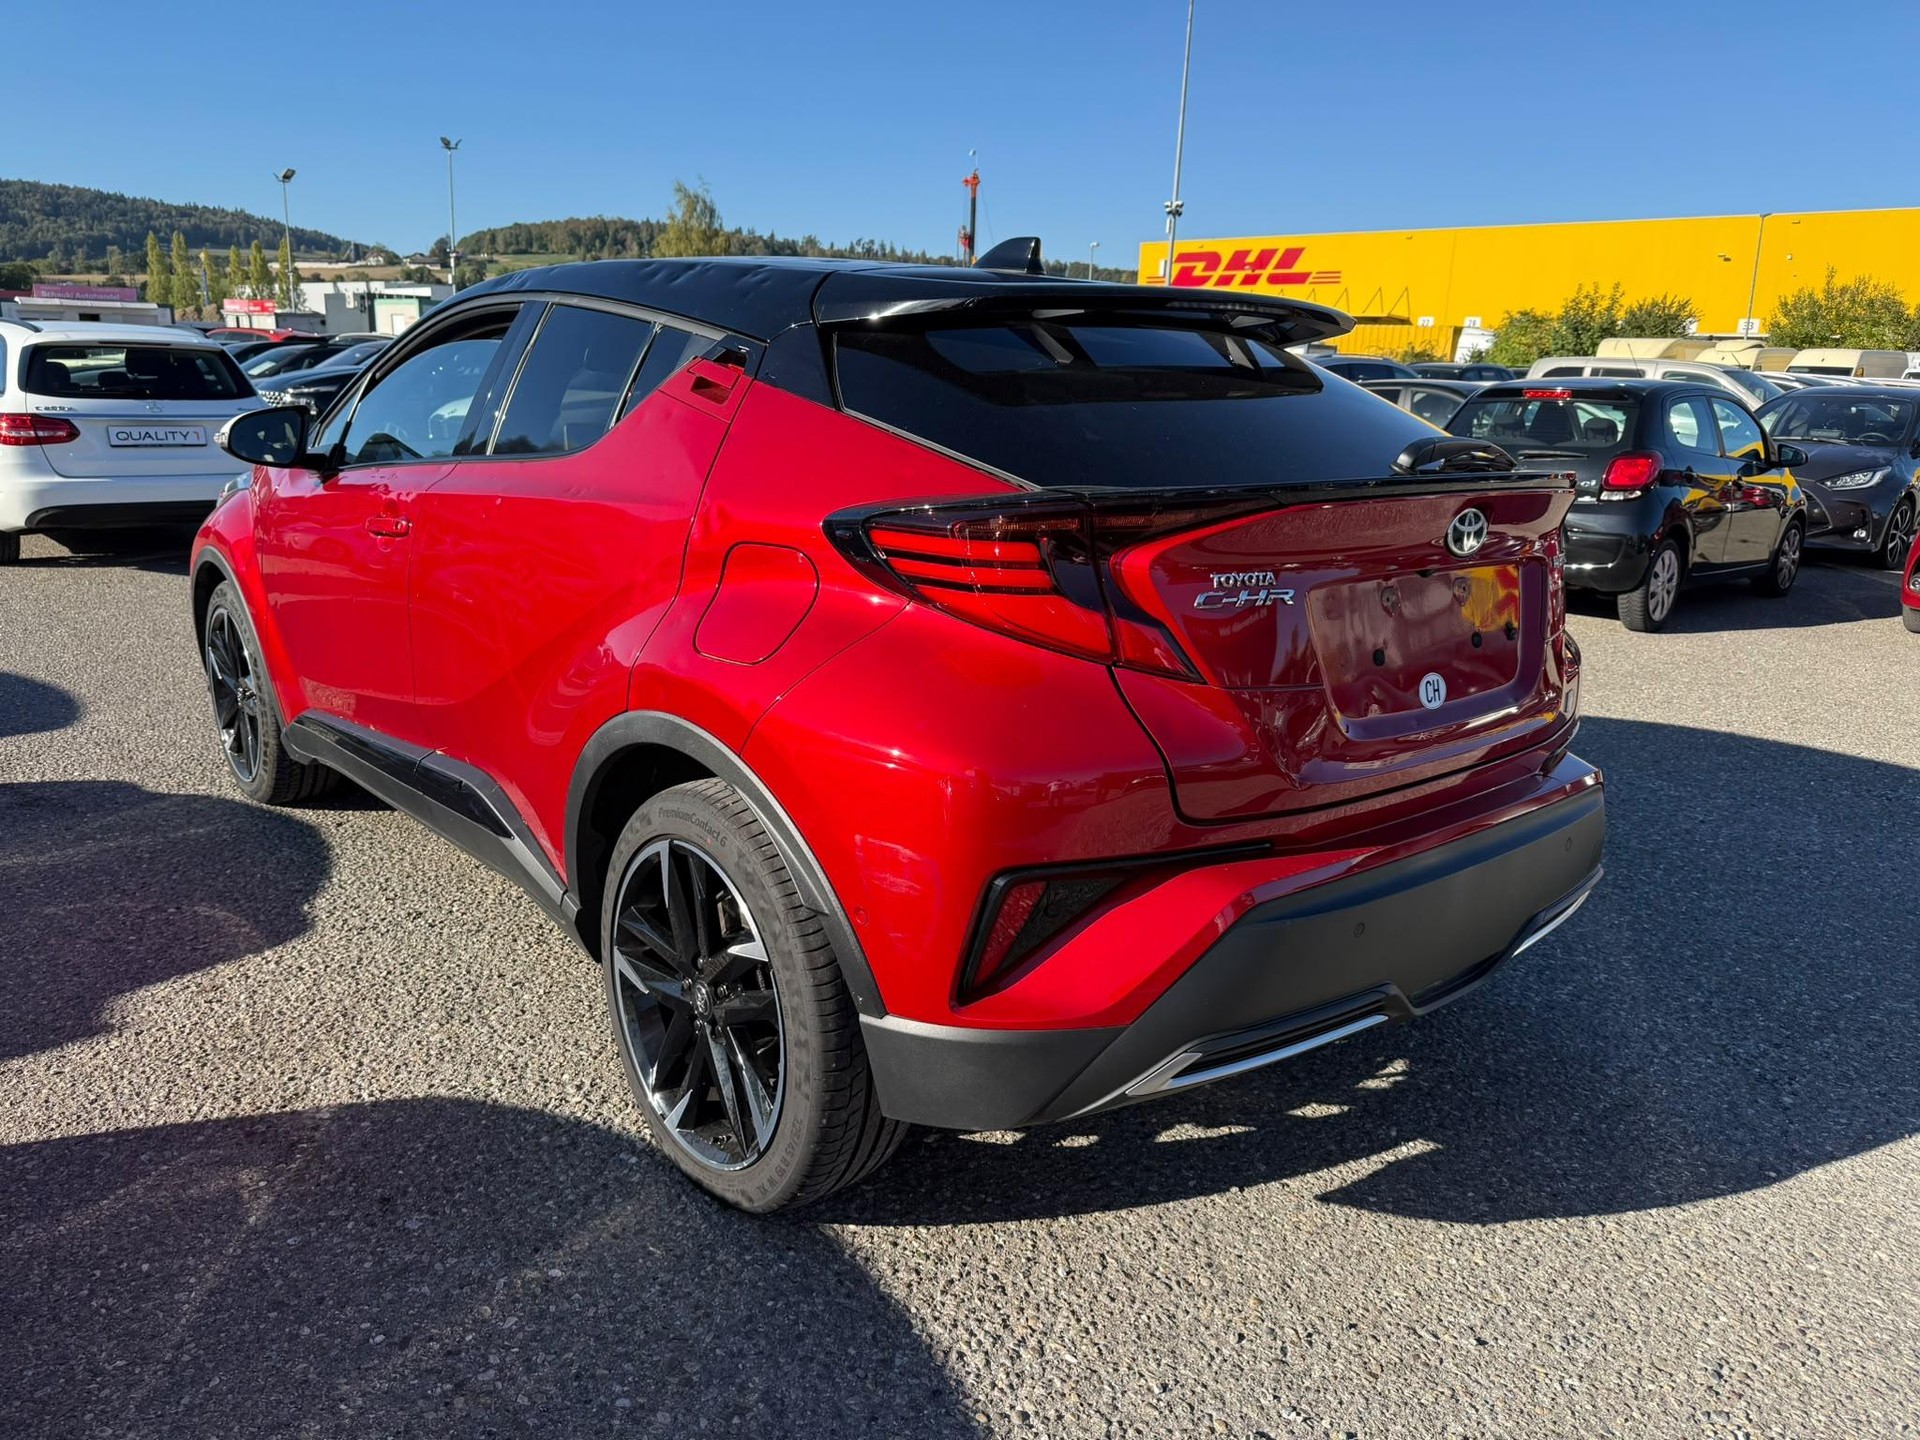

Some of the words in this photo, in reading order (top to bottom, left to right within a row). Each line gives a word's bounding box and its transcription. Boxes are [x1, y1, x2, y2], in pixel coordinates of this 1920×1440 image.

[1171, 247, 1312, 287] DHL
[115, 430, 189, 442] QUALITY
[1210, 571, 1276, 588] TOYOTA
[1194, 589, 1295, 609] C-HR
[1425, 679, 1441, 704] CH
[658, 807, 721, 842] PremiumContact
[720, 836, 728, 848] 6
